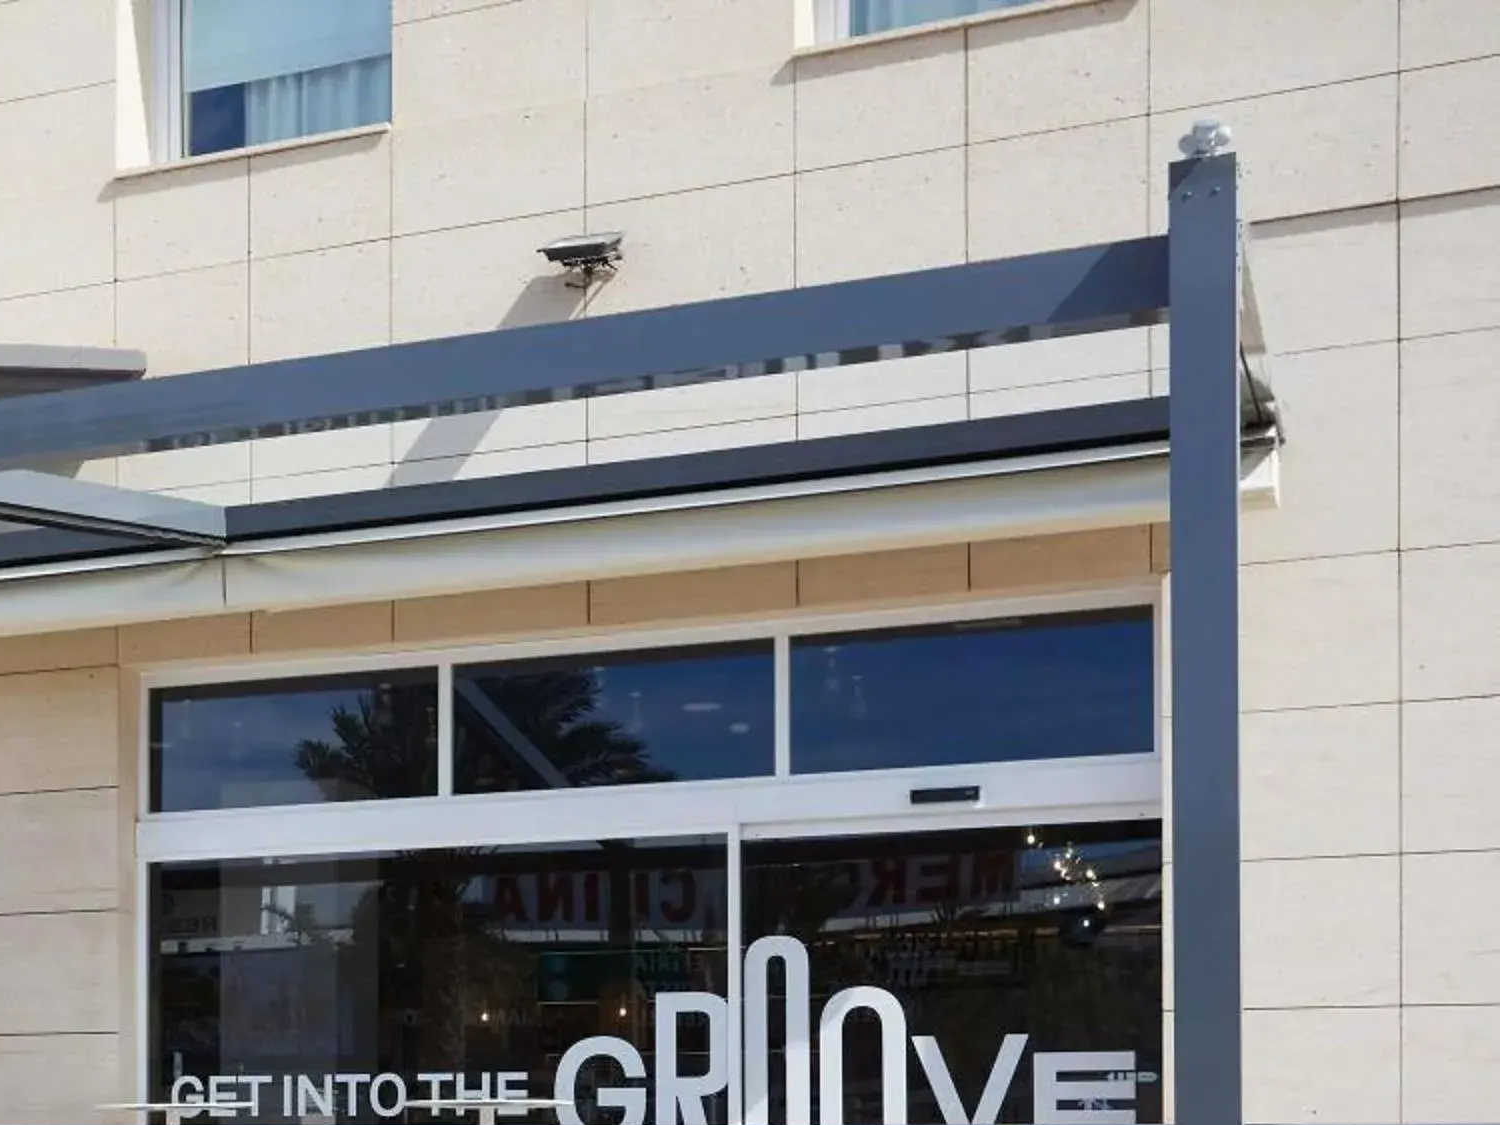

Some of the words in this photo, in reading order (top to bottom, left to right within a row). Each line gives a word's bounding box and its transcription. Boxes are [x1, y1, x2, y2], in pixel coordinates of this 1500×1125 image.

[170, 1074, 273, 1118] GET
[283, 1073, 407, 1117] INTO
[417, 1071, 529, 1117] THE
